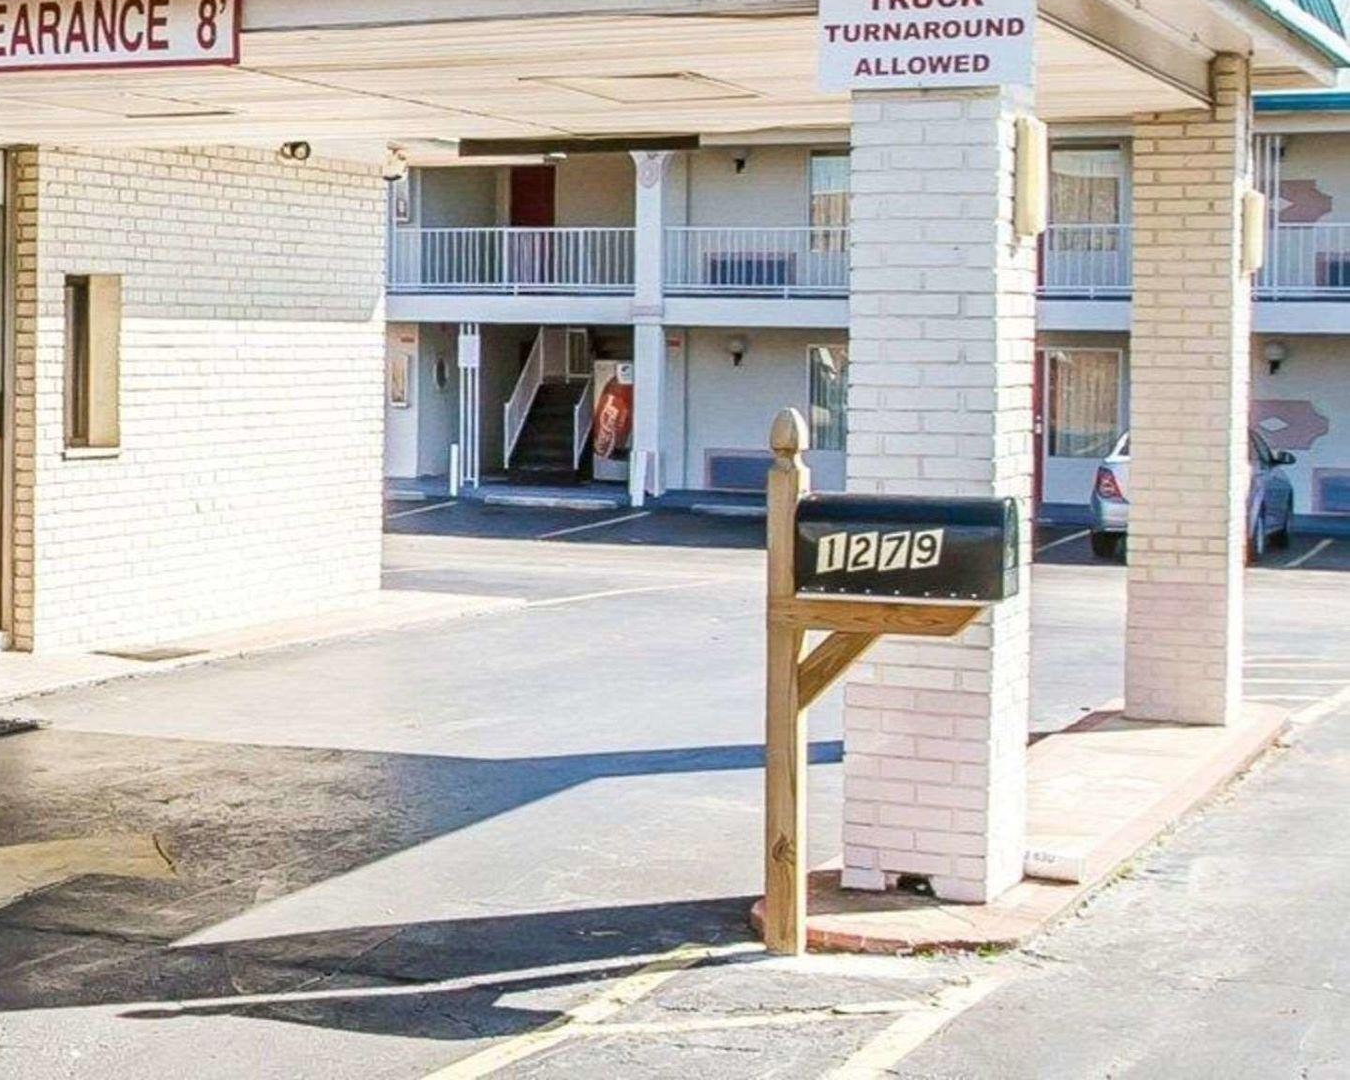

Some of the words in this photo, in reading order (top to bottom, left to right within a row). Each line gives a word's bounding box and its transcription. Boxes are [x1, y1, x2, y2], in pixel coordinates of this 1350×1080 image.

[823, 17, 1026, 43] TURNAROUND
[853, 53, 991, 77] ALLOWED
[825, 532, 939, 570] 1279
